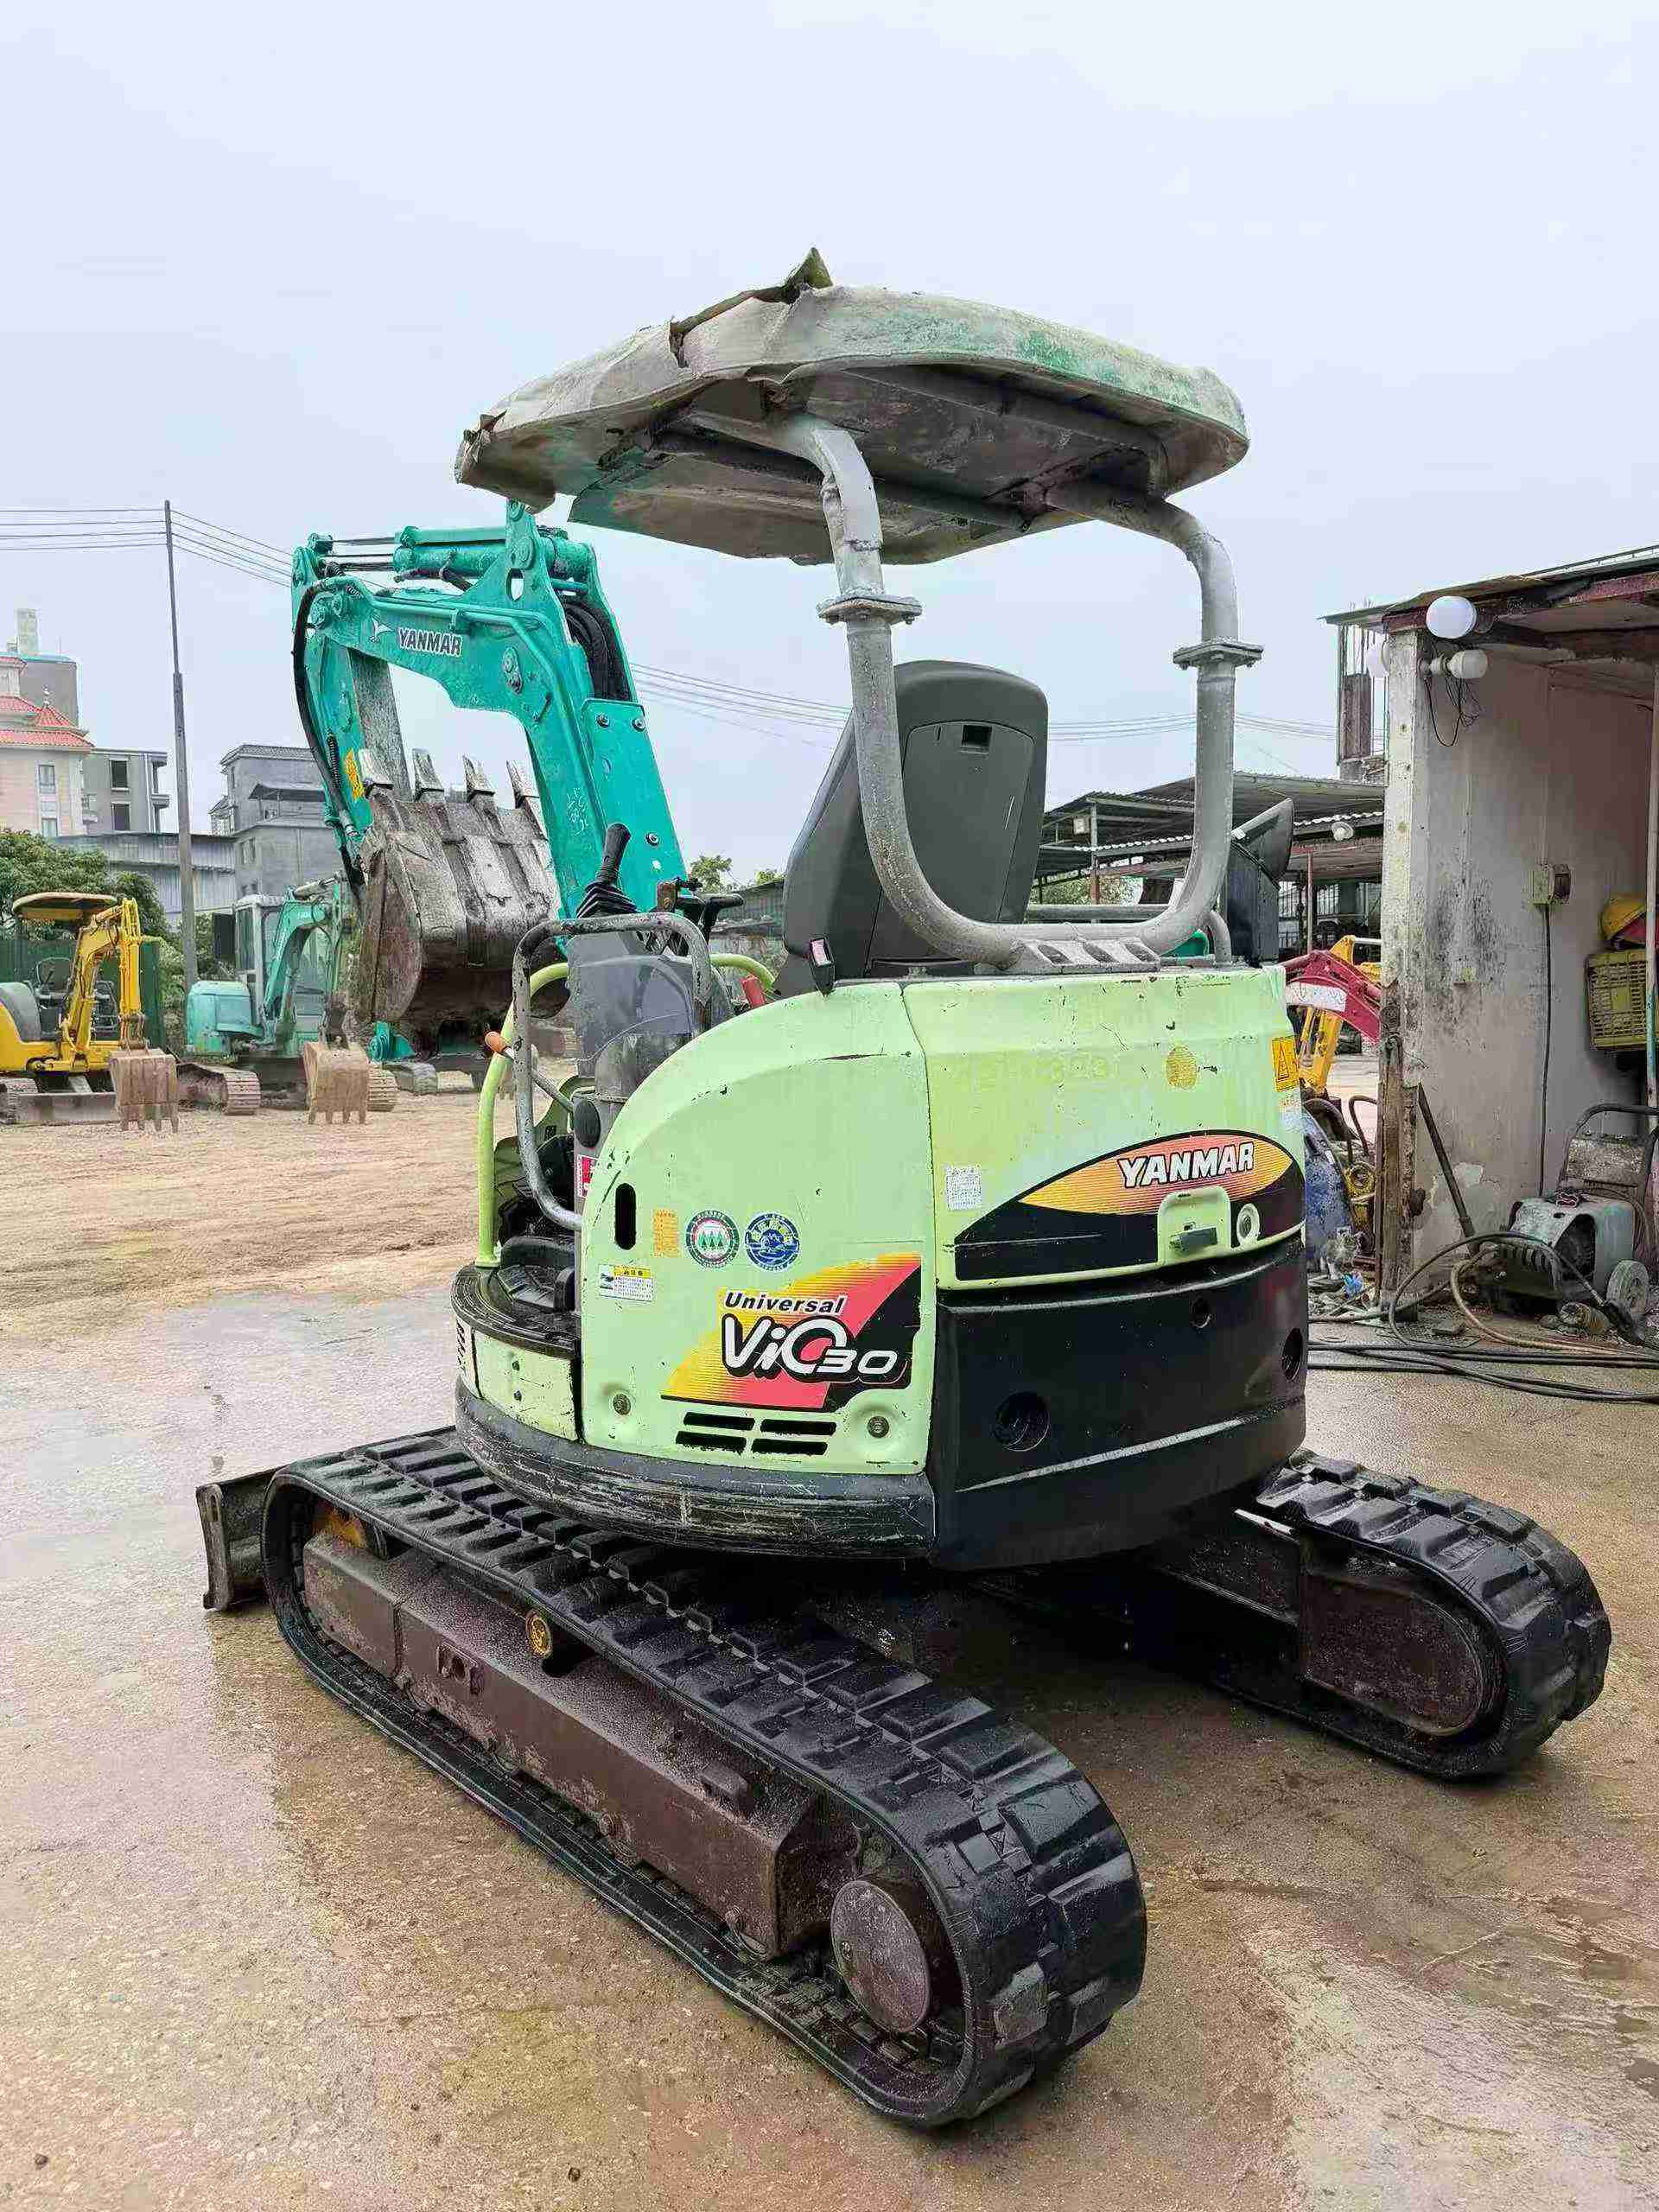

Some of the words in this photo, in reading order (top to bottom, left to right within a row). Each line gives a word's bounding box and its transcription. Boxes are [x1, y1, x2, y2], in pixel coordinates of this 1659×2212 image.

[398, 627, 463, 657] YANMAR
[1118, 1141, 1255, 1188] YANMAR
[724, 1291, 847, 1313] Universal
